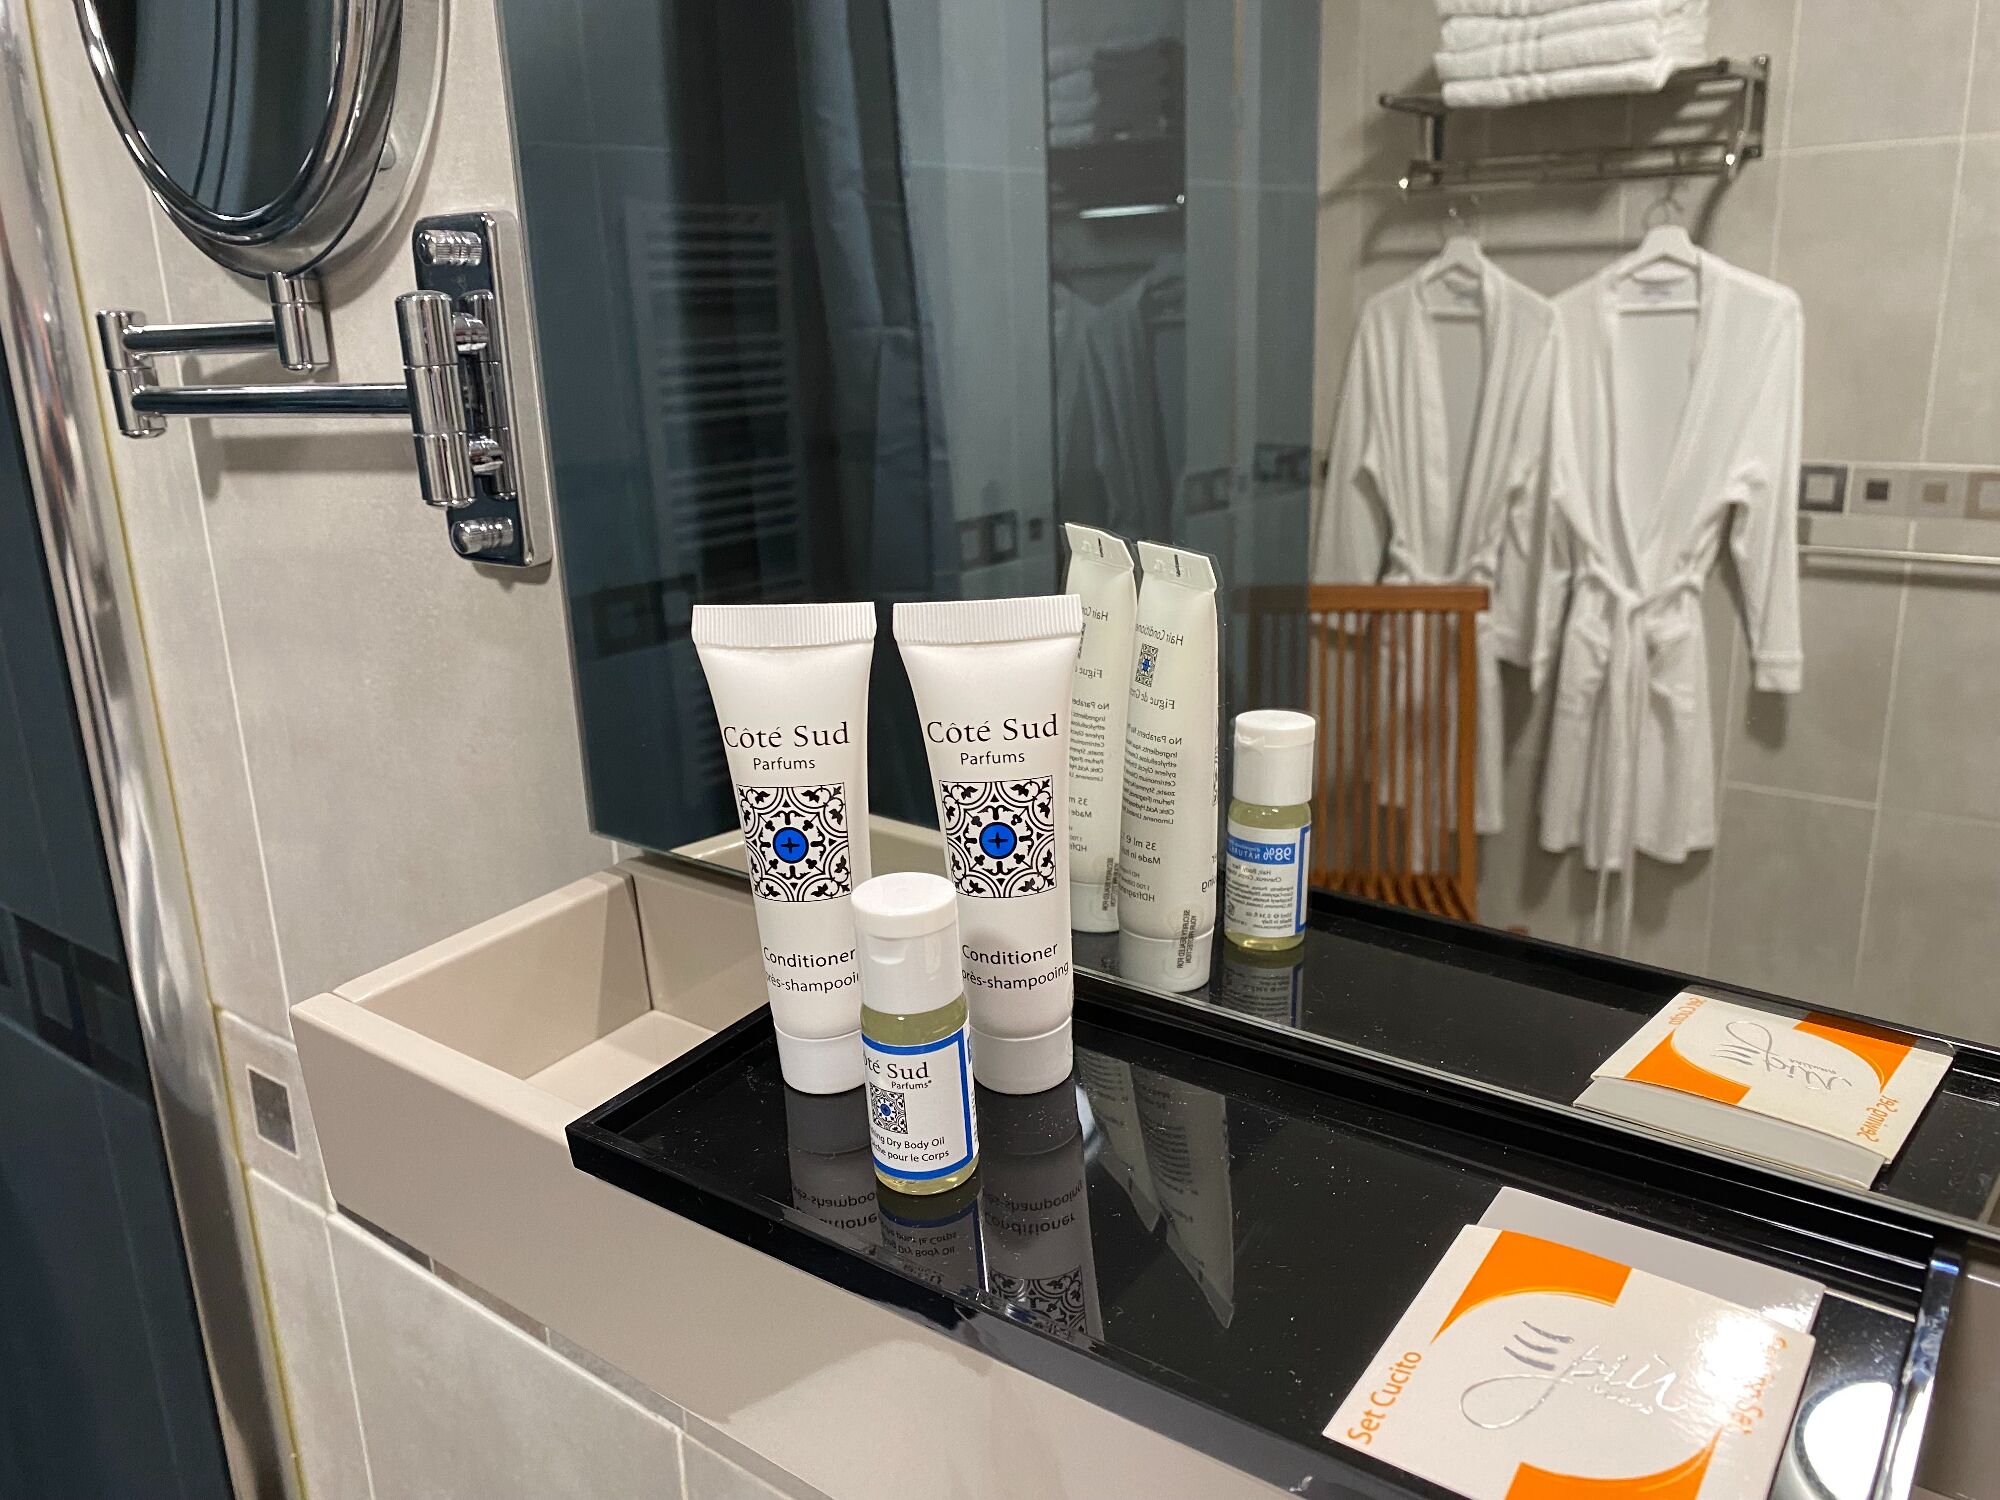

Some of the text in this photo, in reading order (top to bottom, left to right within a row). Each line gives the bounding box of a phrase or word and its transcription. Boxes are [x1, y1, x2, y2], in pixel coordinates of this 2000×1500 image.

[724, 721, 850, 749] Côté Sud
[926, 713, 1059, 745] Côté Sud
[753, 756, 816, 771] Parfums
[960, 751, 1025, 766] Parfums
[764, 947, 855, 968] Conditioner
[962, 944, 1057, 964] Conditioner
[888, 1062, 930, 1079] Sud
[887, 1137, 901, 1149] Dry
[905, 1140, 929, 1150] Body
[932, 1136, 944, 1145] Oil
[888, 1153, 908, 1161] pour
[911, 1153, 919, 1162] le
[922, 1151, 949, 1161] Corps
[1346, 1350, 1423, 1447] Set Cucito
